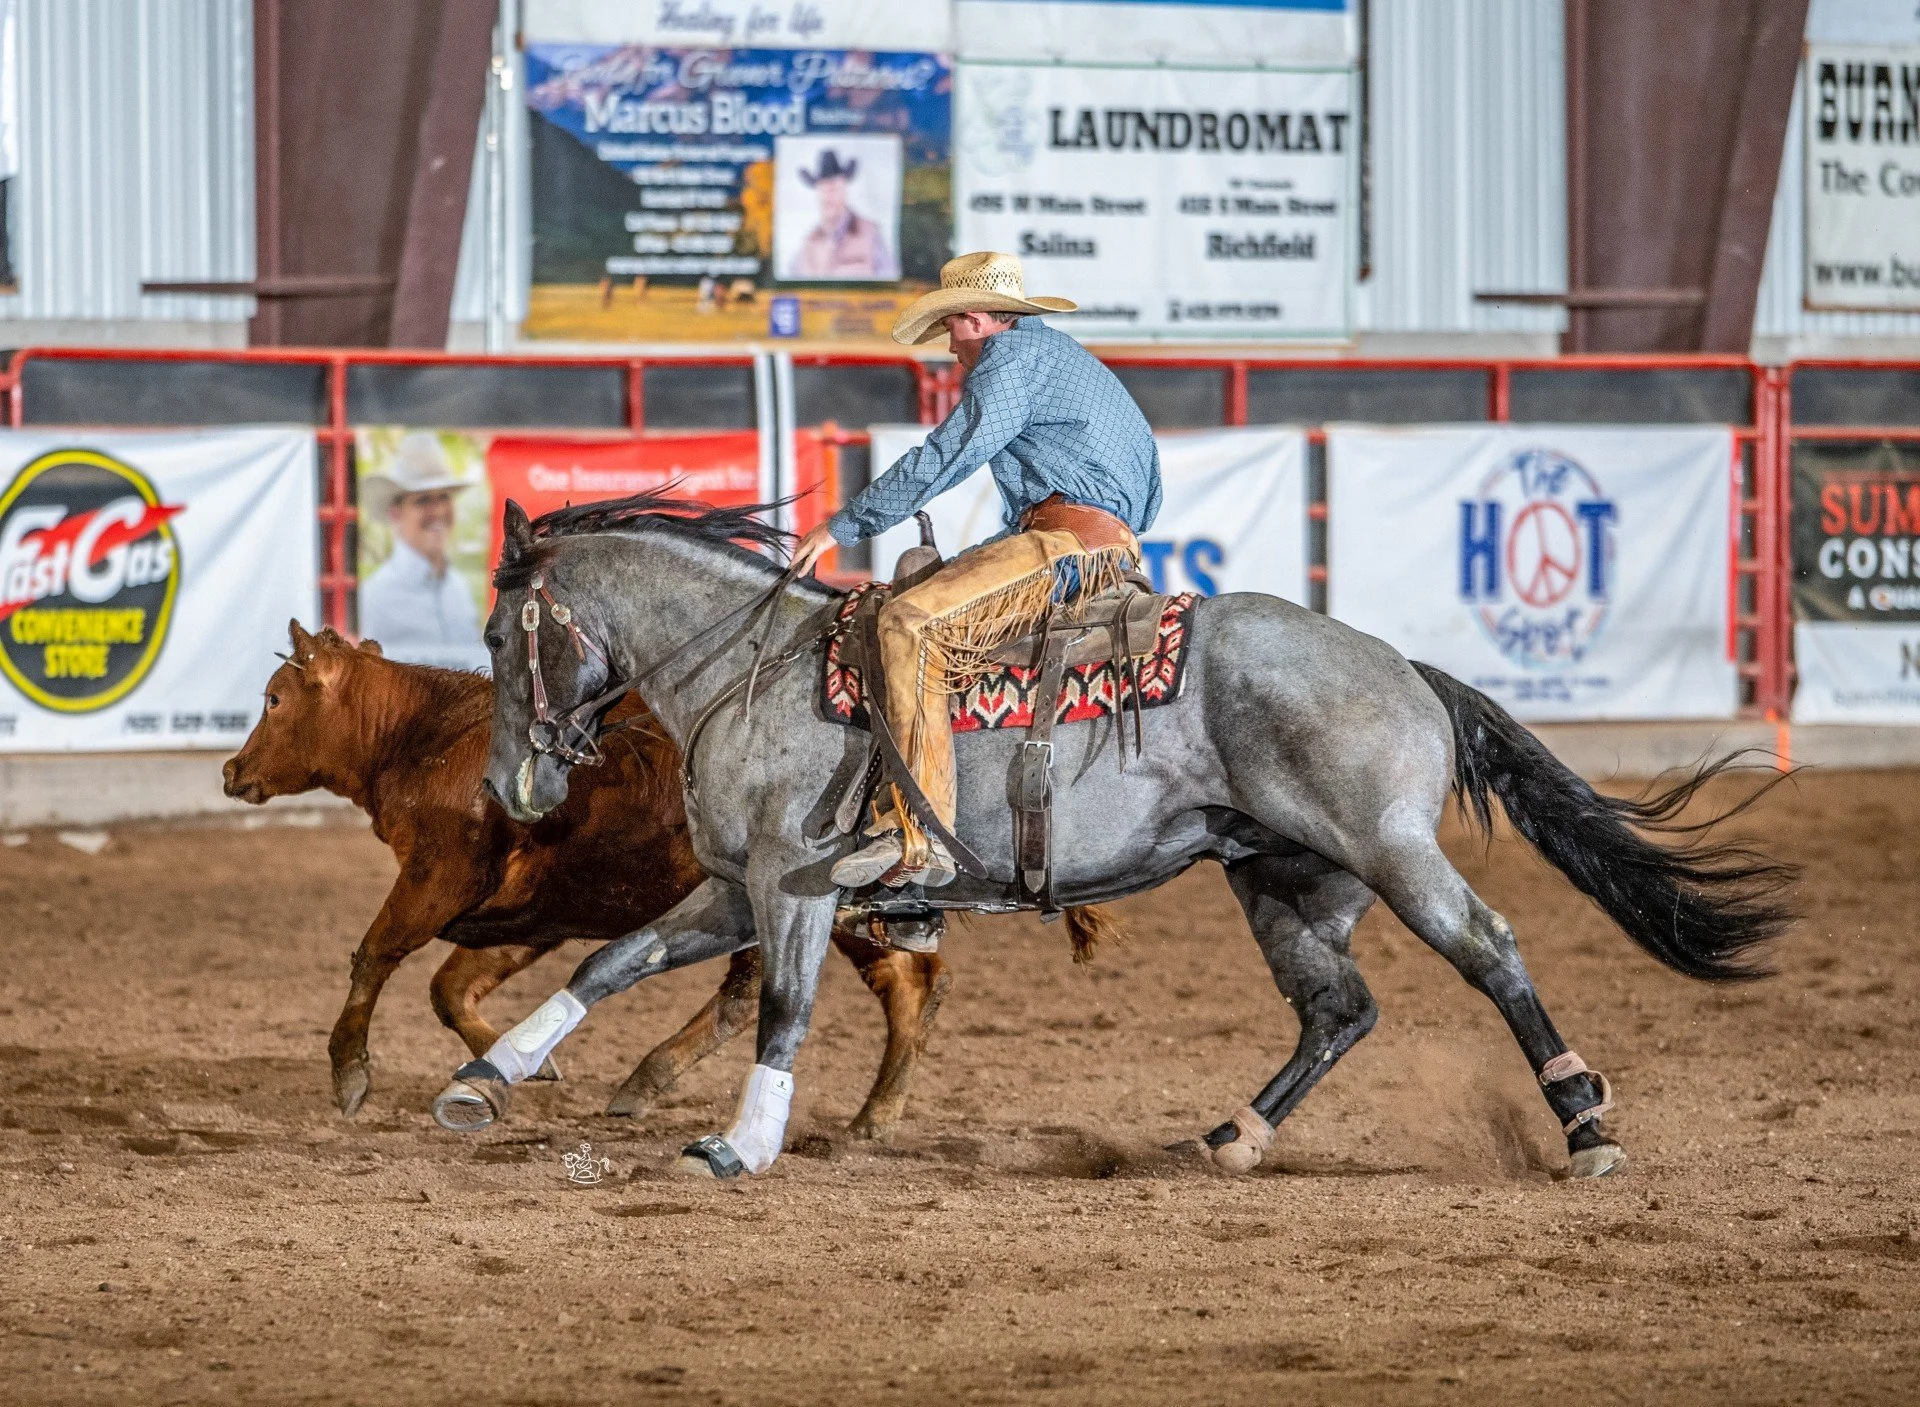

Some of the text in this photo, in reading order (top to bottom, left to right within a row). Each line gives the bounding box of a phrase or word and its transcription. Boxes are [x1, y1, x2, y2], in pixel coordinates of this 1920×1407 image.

[584, 94, 708, 134] Marcus
[711, 92, 804, 135] Blood
[1049, 107, 1349, 152] LAUNDROMAT
[1819, 160, 1867, 196] The
[1039, 194, 1083, 213] Main
[1092, 195, 1146, 215] Street
[1233, 197, 1280, 214] Main
[1288, 198, 1337, 215] Street
[1019, 231, 1096, 257] Salina
[1206, 232, 1316, 260] Richfield
[1459, 501, 1617, 608] HOT
[1819, 537, 1920, 579] CON
[11, 608, 146, 644] CONVENIENCE
[44, 644, 109, 678] STORE
